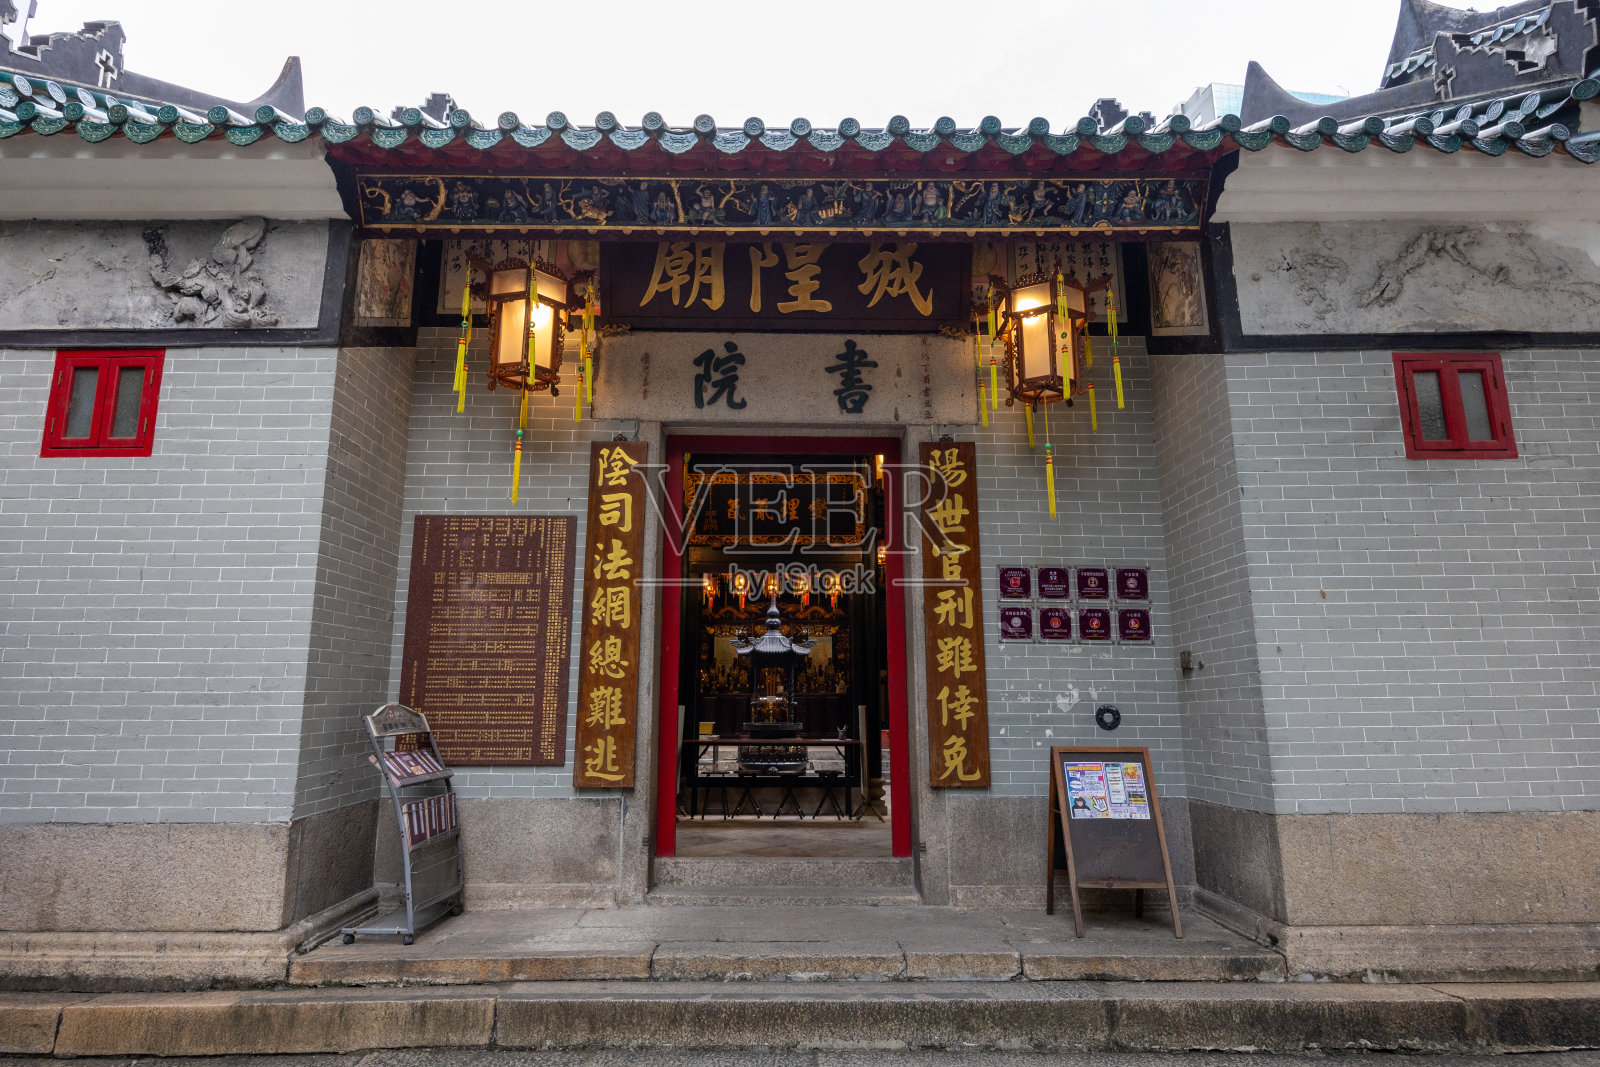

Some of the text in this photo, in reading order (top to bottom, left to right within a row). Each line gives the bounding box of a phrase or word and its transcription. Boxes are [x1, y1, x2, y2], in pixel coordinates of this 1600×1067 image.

[693, 339, 879, 413] 書院
[584, 446, 639, 781] 陰司法網總難逃
[929, 447, 981, 781] 陽世官刑雖倖免
